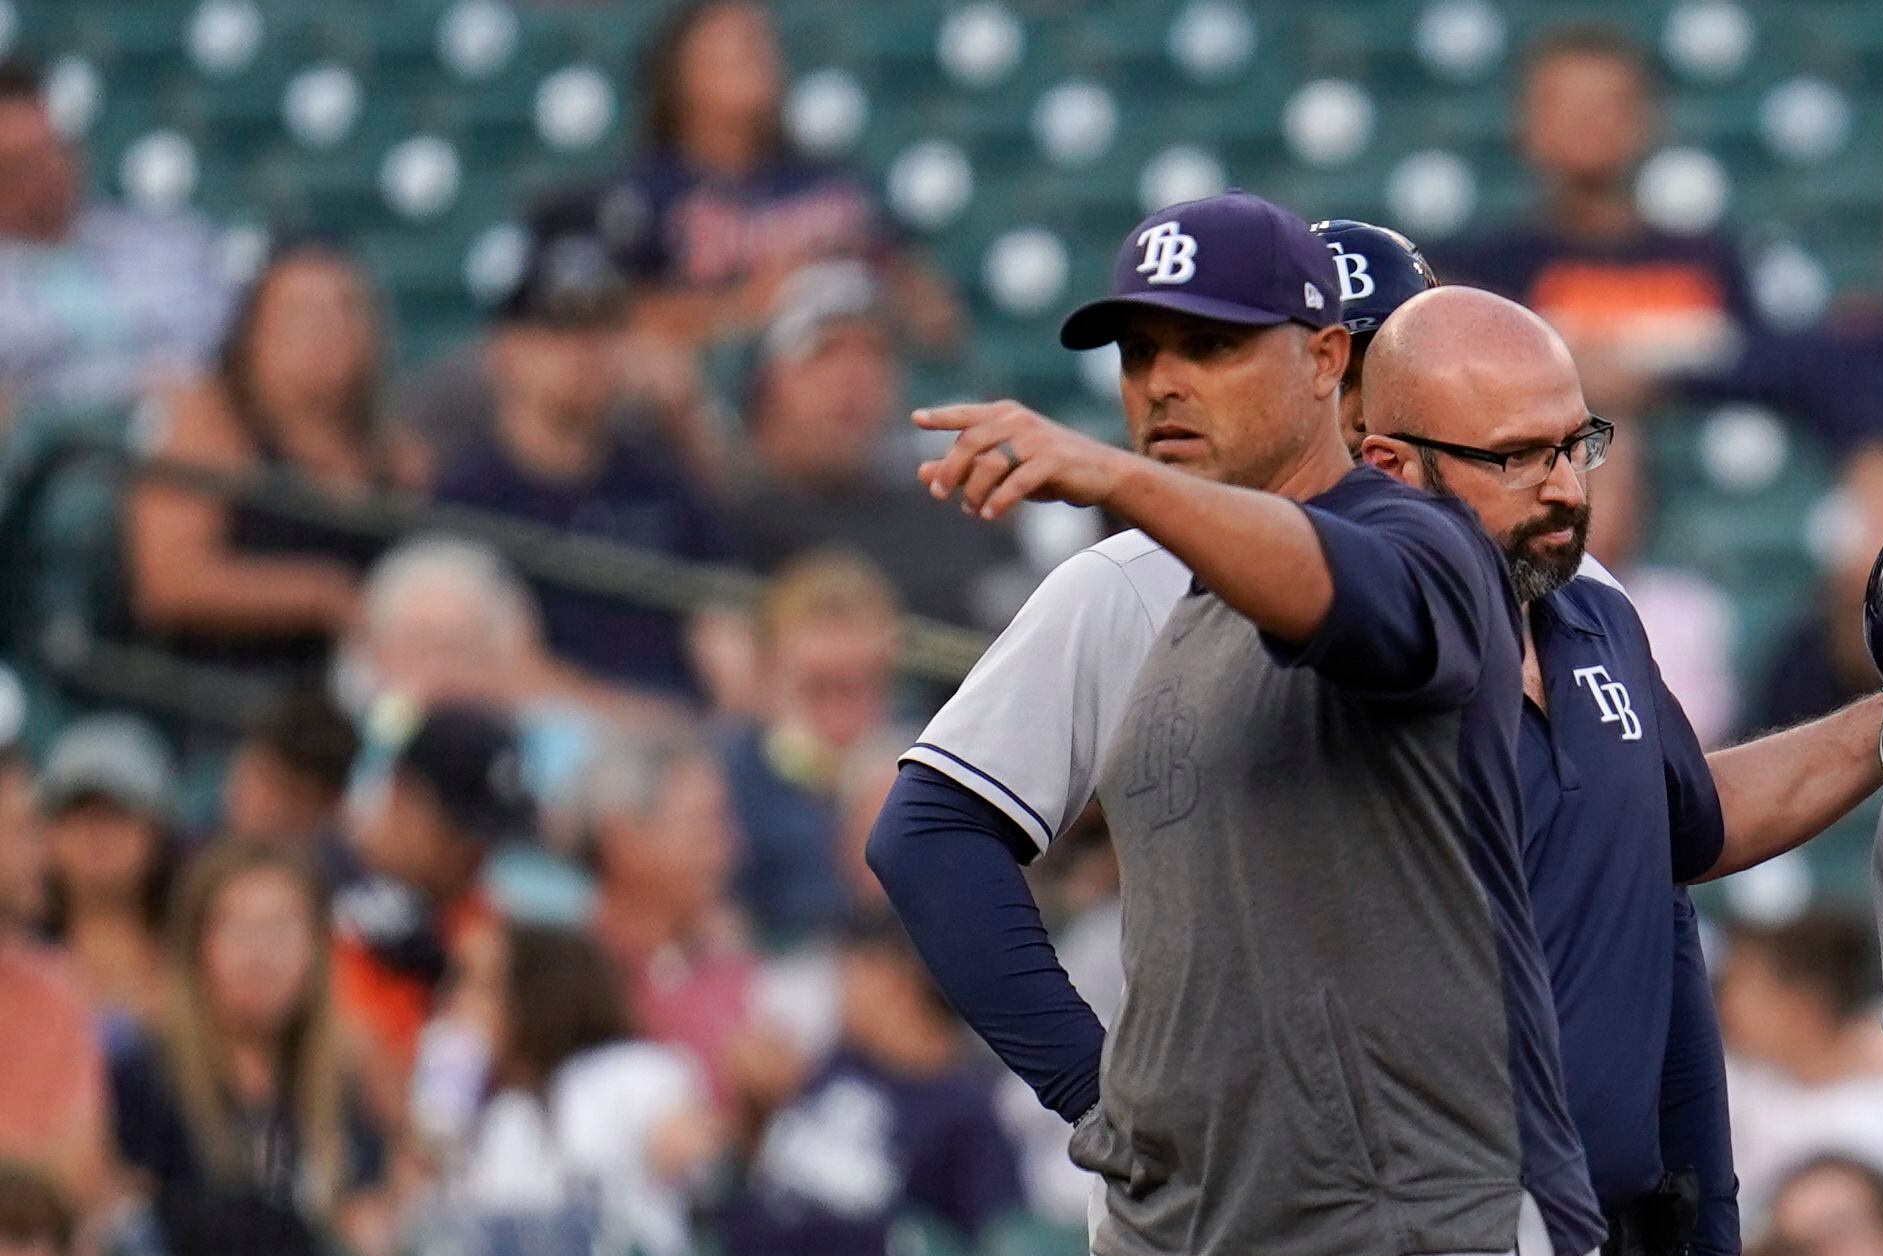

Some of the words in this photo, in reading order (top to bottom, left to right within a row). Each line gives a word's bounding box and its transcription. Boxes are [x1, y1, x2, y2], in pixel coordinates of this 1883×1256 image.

[1136, 220, 1199, 286] TB
[1326, 242, 1376, 301] B
[1572, 664, 1643, 740] TB
